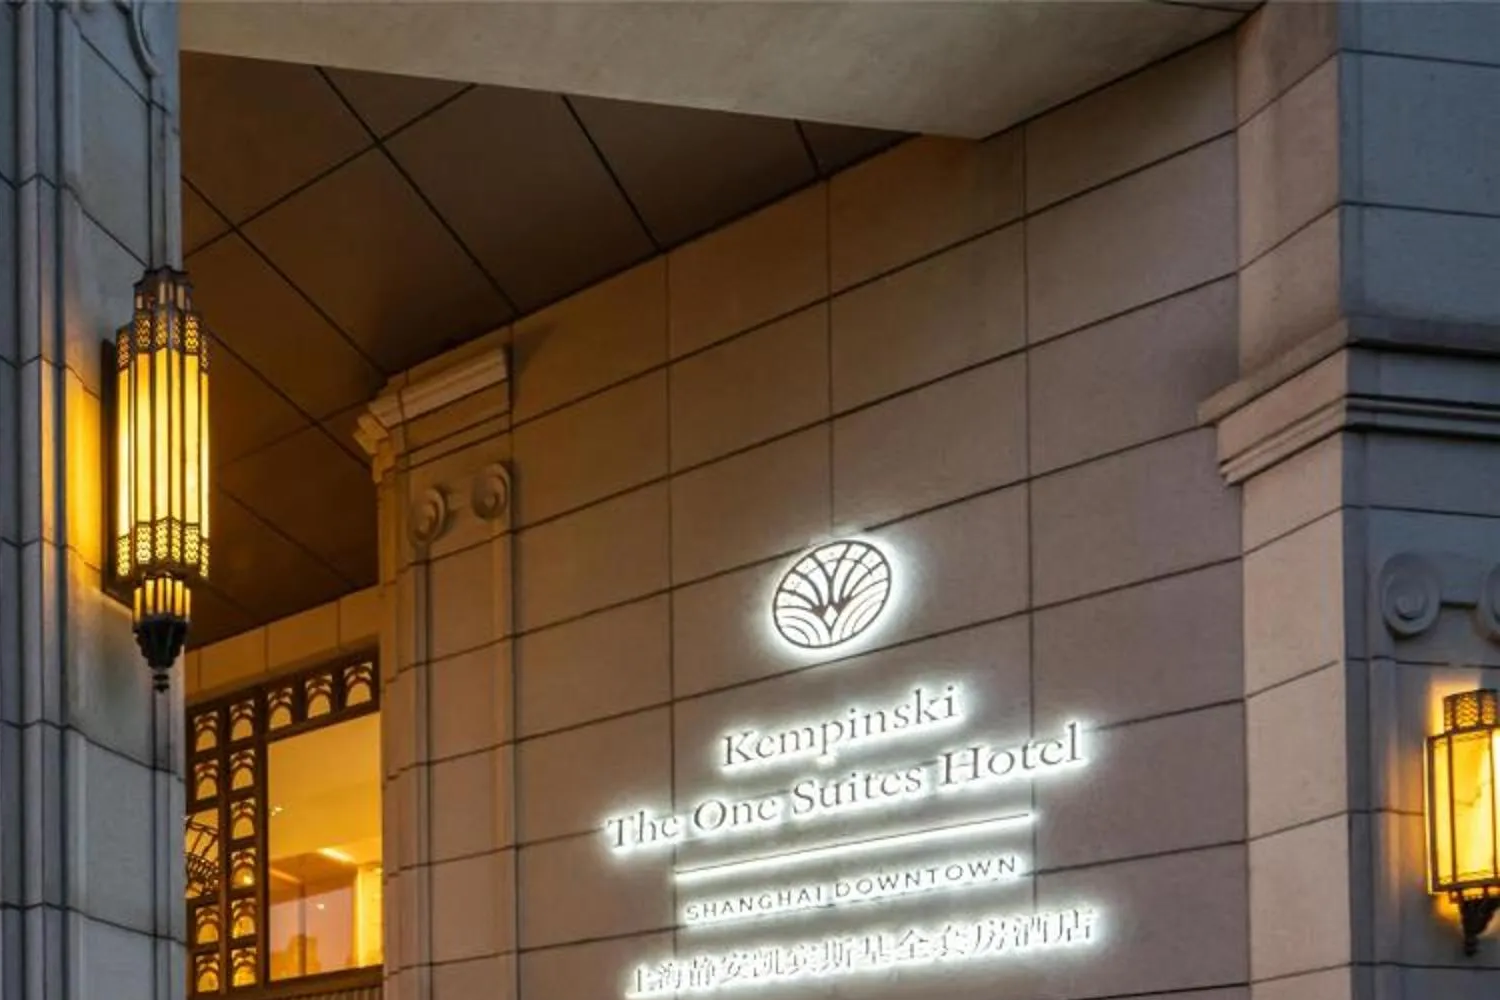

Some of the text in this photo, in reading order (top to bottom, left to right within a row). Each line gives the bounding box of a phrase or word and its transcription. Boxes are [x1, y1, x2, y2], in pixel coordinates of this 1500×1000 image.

[722, 684, 962, 768] Kempinski
[607, 721, 1083, 849] The One Suites Hotel
[685, 855, 1017, 921] SHANGHAI DOWNTOWN
